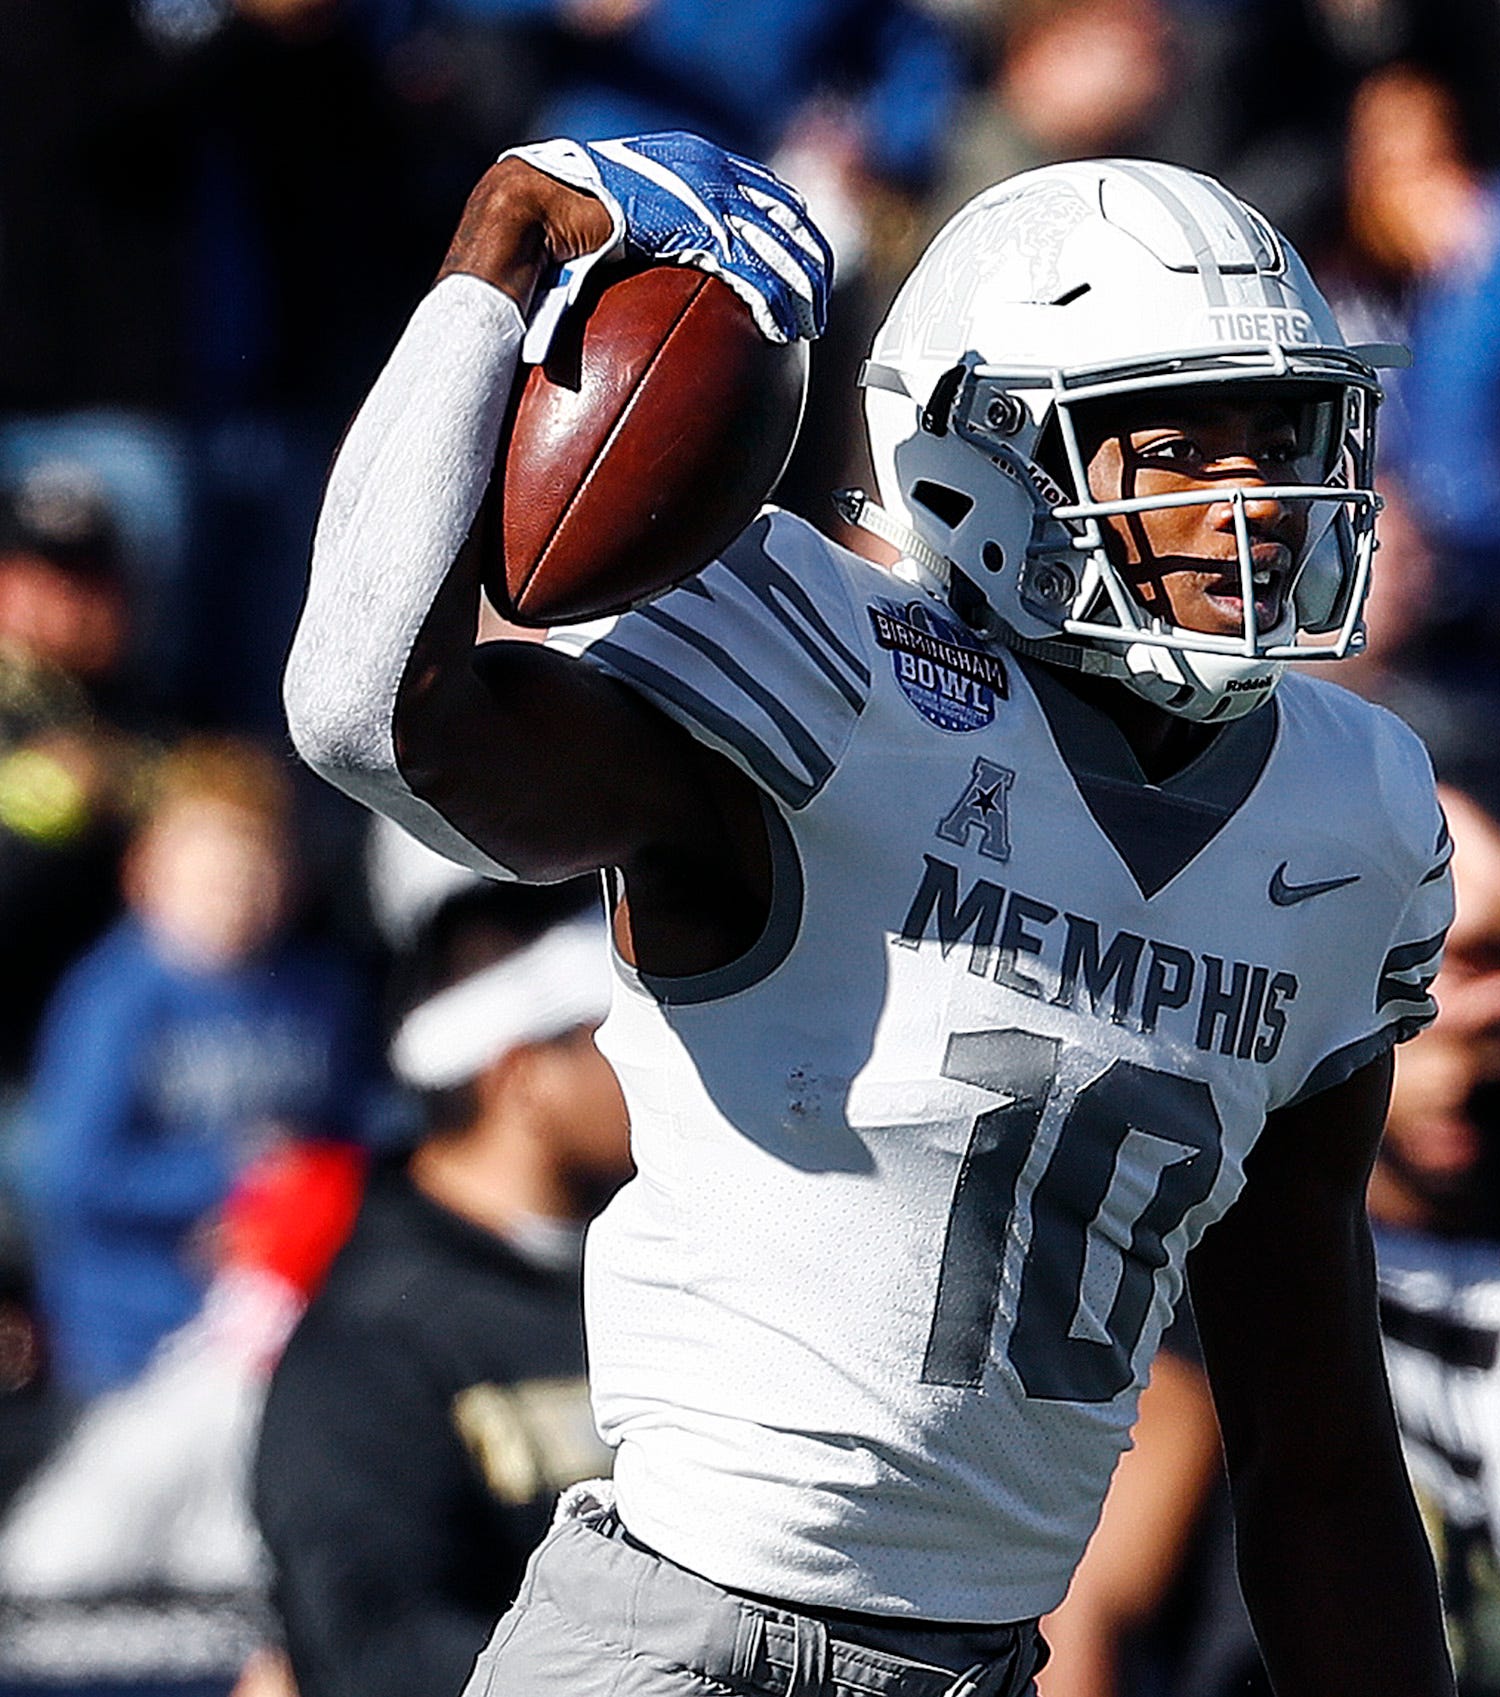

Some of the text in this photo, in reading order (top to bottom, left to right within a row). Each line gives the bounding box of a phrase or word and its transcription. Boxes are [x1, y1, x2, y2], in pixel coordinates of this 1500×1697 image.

[1208, 313, 1309, 343] TIGERS
[876, 614, 1004, 689] BIRMINGHAM
[900, 652, 990, 713] BOWL
[936, 755, 1016, 862] A
[891, 852, 1298, 1064] MEMPHIS
[920, 1026, 1223, 1402] 10
